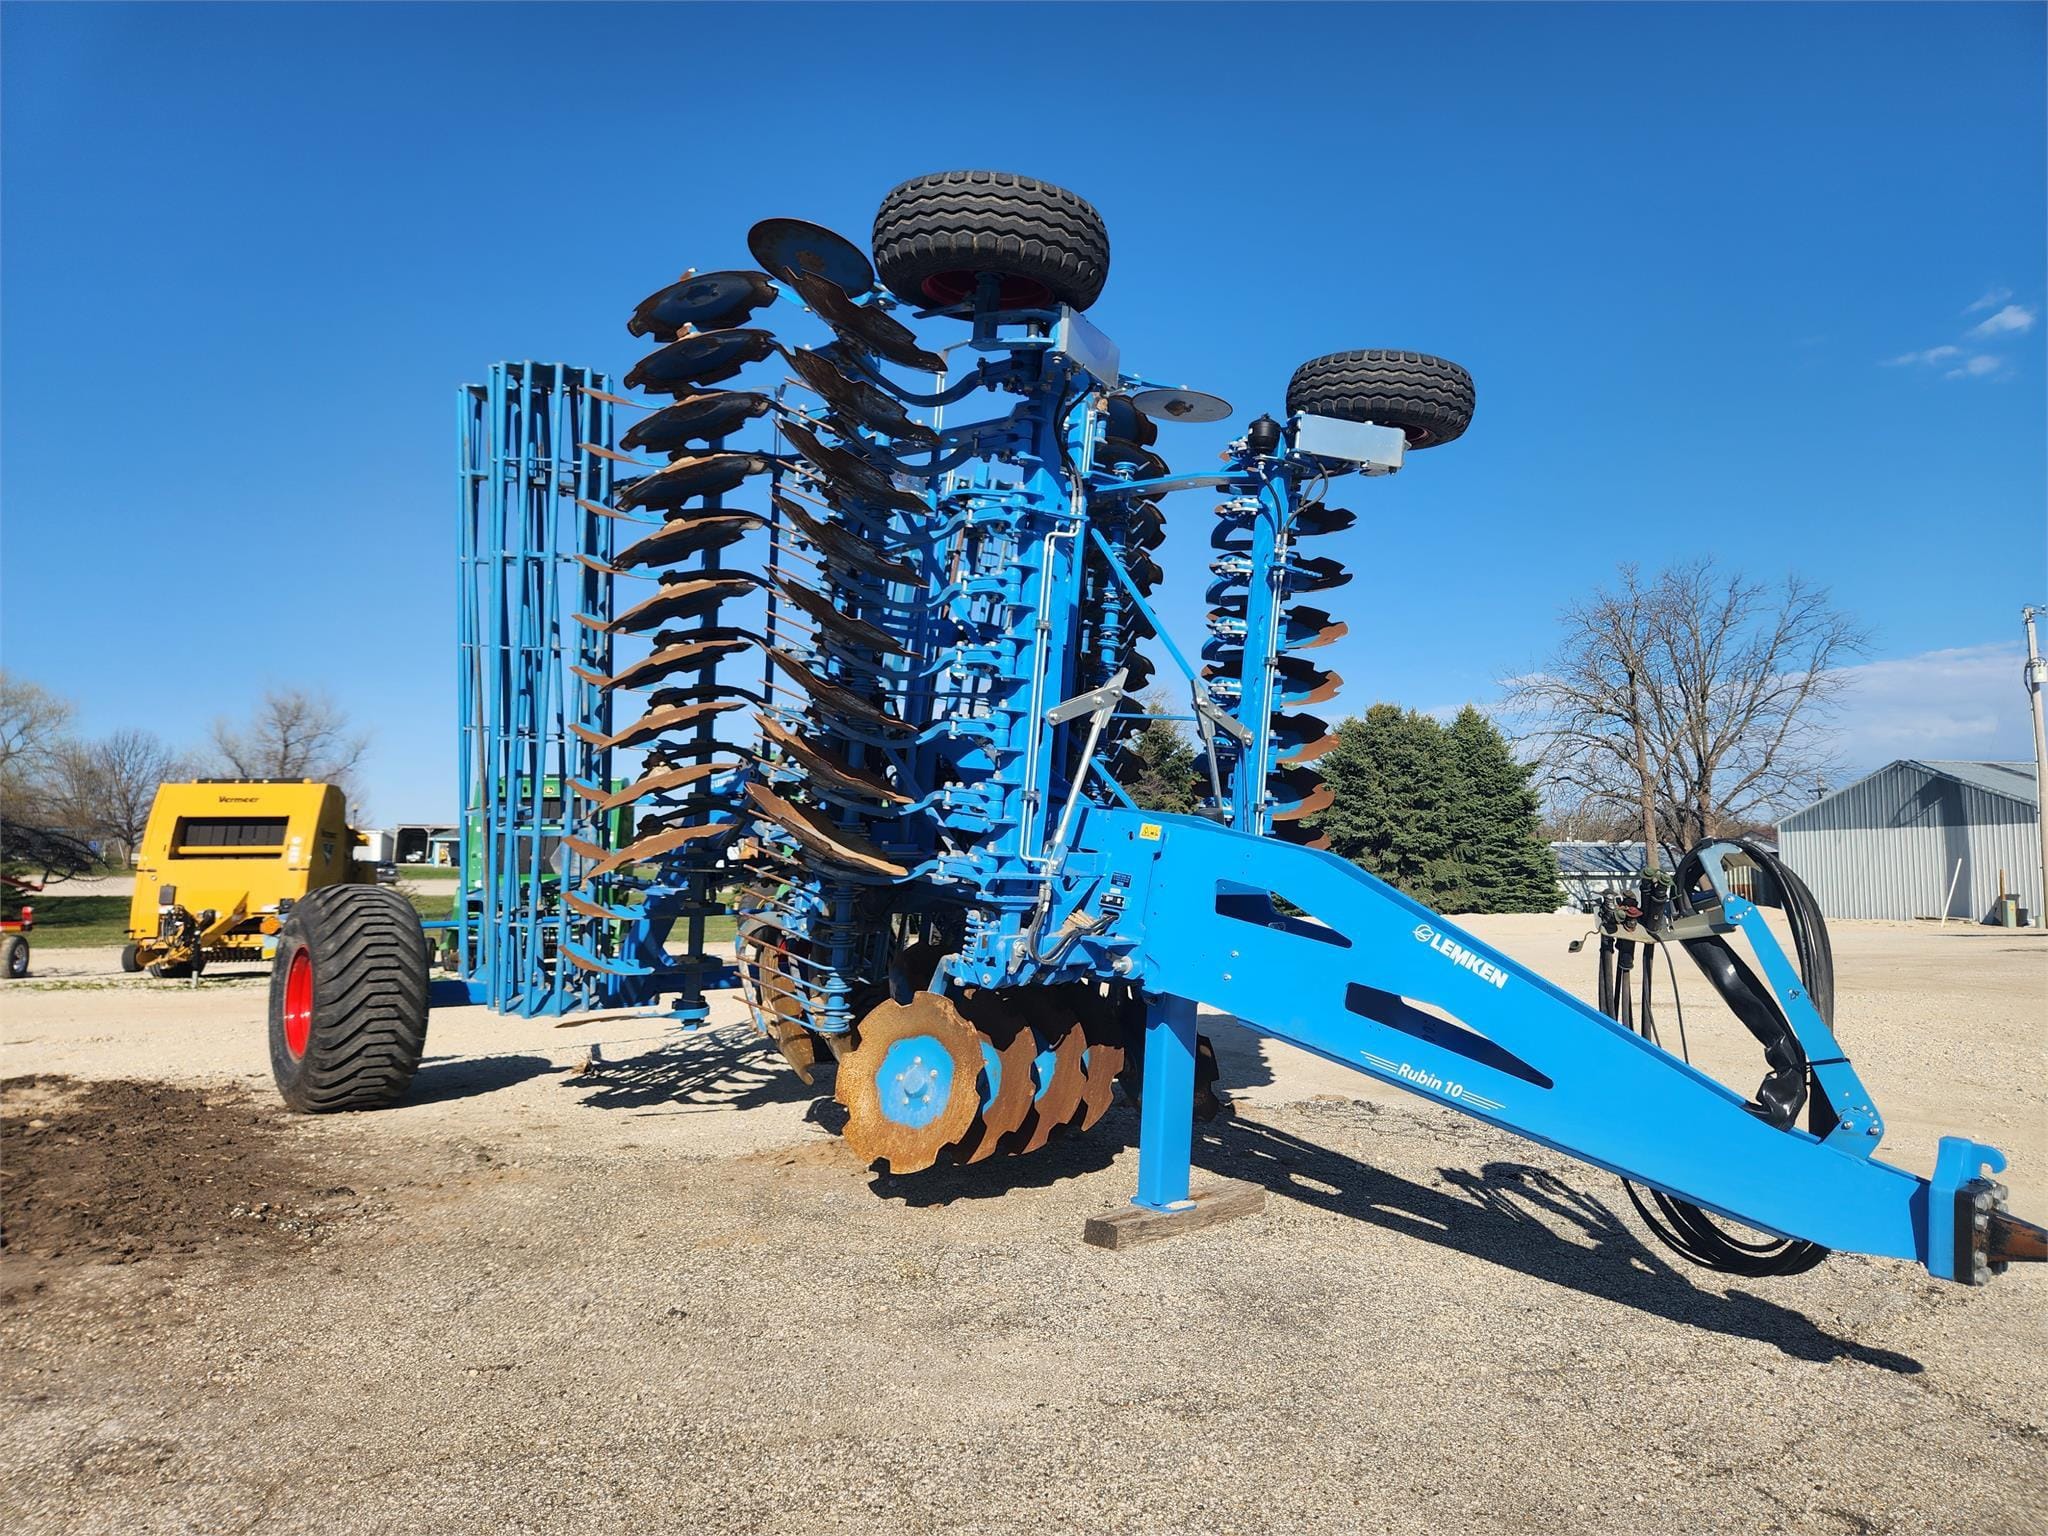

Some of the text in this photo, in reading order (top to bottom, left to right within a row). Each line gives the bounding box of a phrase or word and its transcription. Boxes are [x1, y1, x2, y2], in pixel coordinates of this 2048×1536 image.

[1430, 933, 1509, 989] LEMKEN
[1397, 1063, 1463, 1098] Rubin 10
